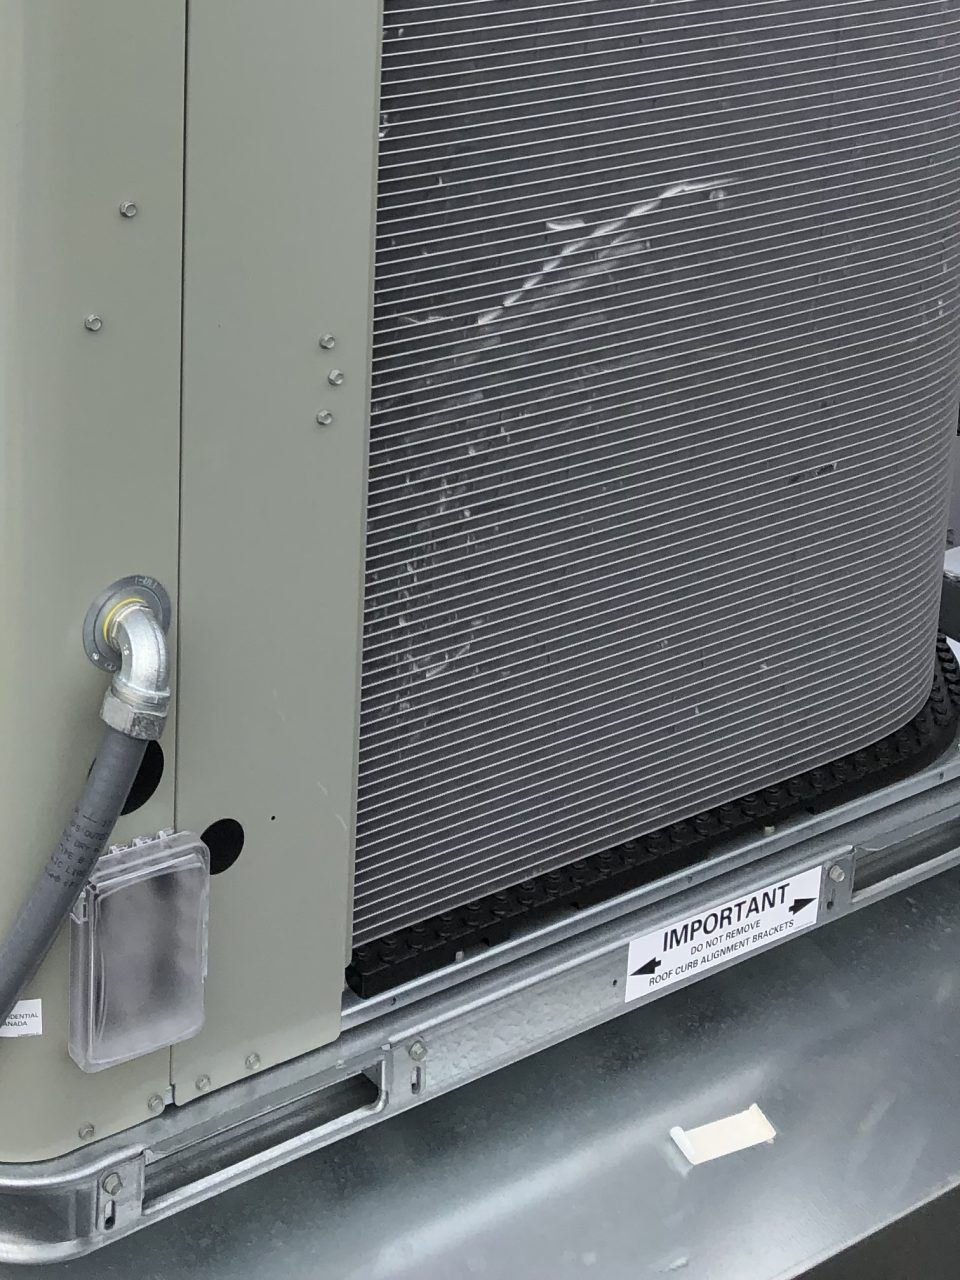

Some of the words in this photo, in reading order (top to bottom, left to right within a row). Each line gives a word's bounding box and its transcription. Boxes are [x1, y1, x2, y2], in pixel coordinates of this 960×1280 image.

[663, 883, 790, 952] IMPORTANT
[690, 943, 704, 955] DO
[705, 935, 724, 951] NOT
[725, 920, 761, 941] REMOVE
[649, 971, 674, 986] ROOF
[675, 959, 699, 975] CURB
[701, 937, 750, 964] ALIGNMENT
[752, 919, 795, 943] BRACKETS
[8, 1012, 39, 1020] DENTIAL
